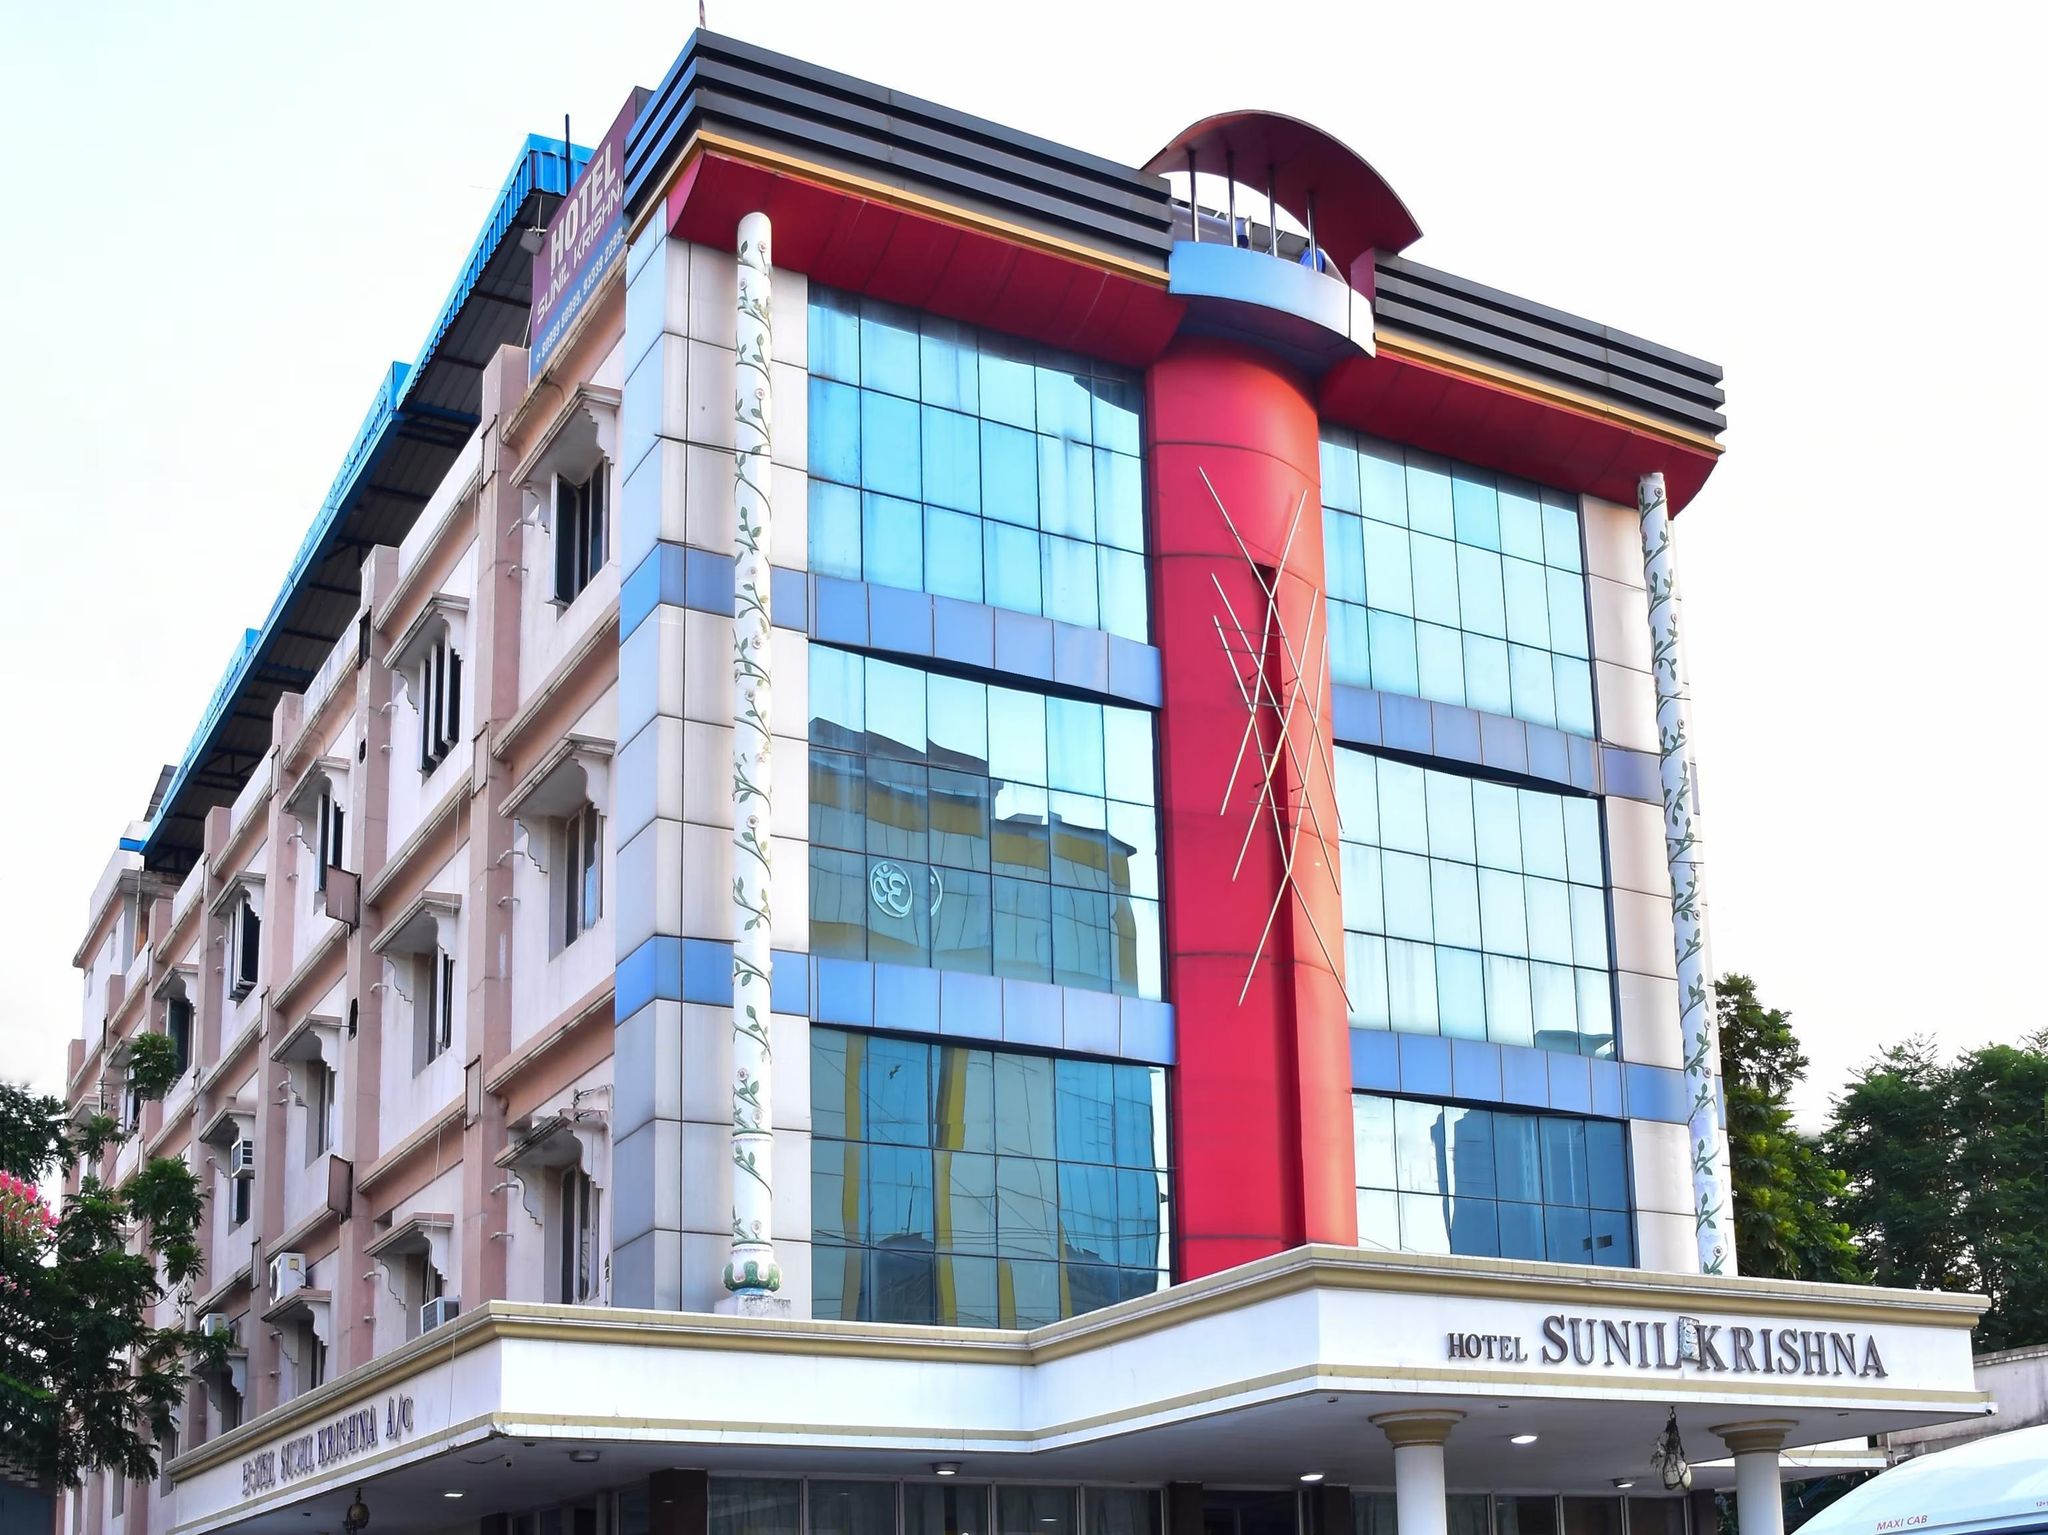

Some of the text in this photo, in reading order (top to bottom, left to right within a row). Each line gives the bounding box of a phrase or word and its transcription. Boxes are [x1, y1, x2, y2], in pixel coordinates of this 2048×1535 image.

[550, 142, 617, 274] HOTEL
[1447, 1314, 1889, 1378] HOTEL SUNIL KRISHNA
[318, 1404, 378, 1467] KRISHNA
[386, 1393, 414, 1440] A/C
[1876, 1514, 1928, 1531] MAXI CAB
